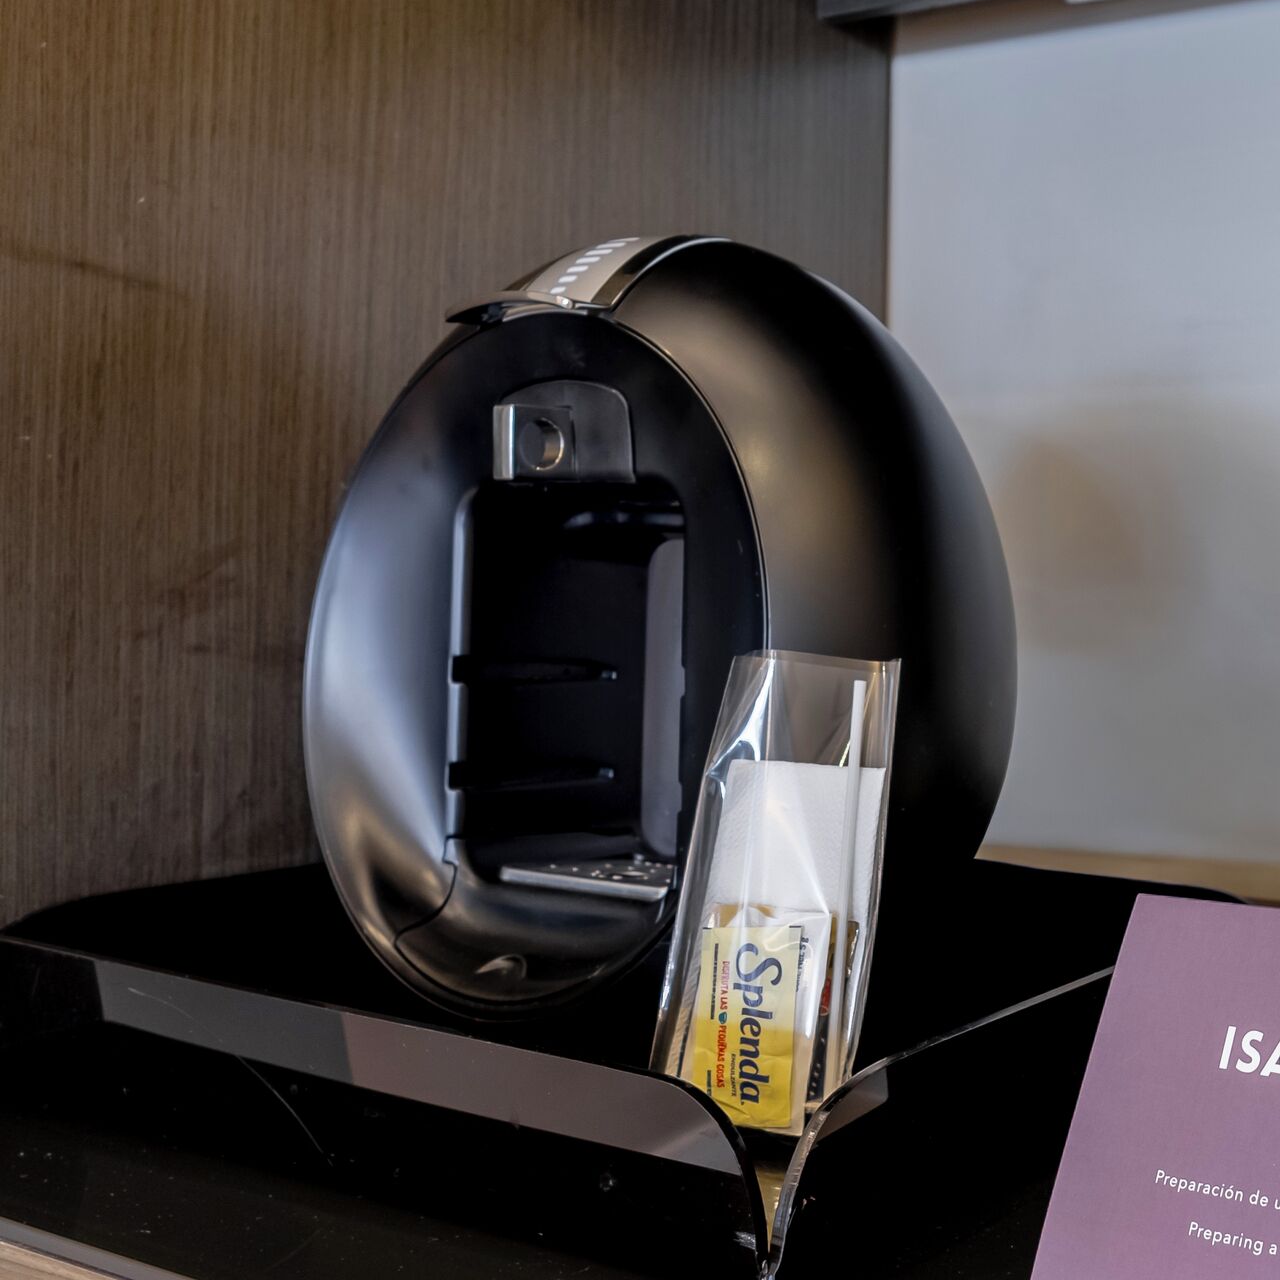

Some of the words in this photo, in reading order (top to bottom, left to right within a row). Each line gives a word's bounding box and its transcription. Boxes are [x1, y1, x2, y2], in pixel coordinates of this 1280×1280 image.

[721, 960, 730, 995] DISFRUTA
[720, 996, 728, 1010] LAS
[733, 942, 783, 1105] Splenda
[716, 1063, 725, 1088] COSAS
[1155, 1170, 1244, 1202] Preparación
[1249, 1190, 1269, 1207] de
[1188, 1221, 1264, 1256] Preparing
[1268, 1243, 1278, 1255] a
